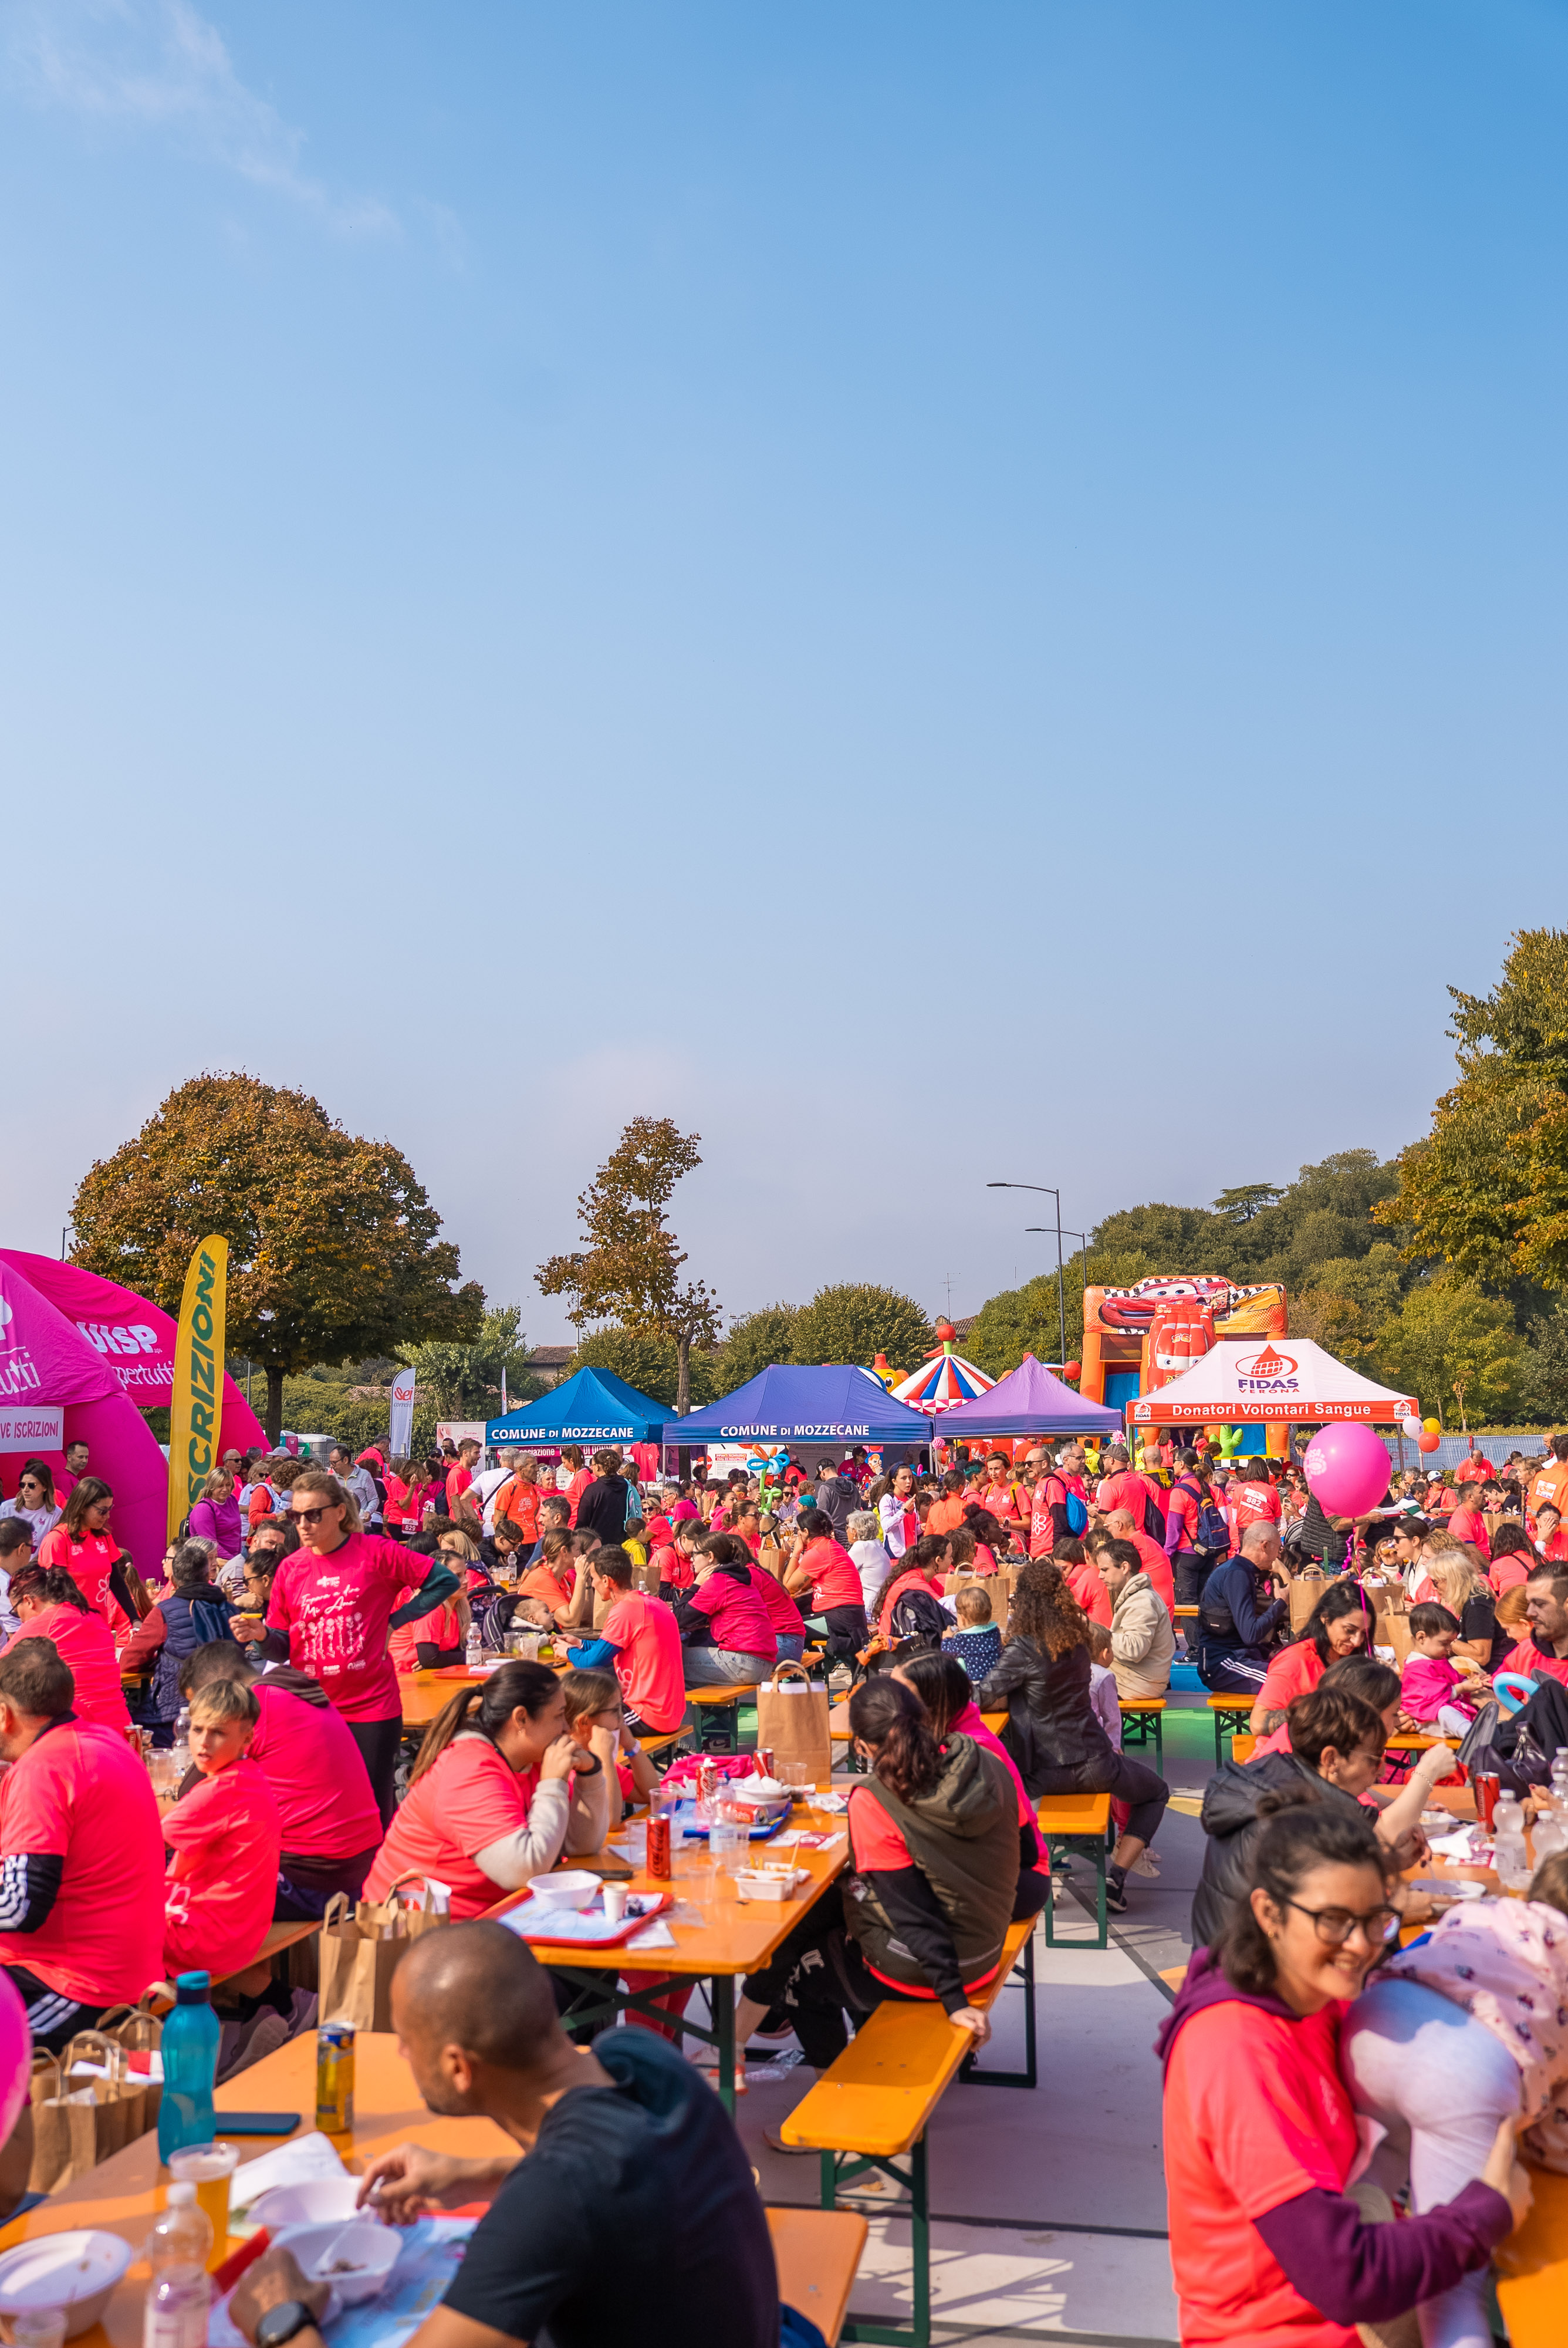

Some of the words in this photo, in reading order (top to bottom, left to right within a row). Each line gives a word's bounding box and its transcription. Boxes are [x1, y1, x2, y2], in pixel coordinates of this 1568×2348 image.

[76, 1321, 157, 1354] UISP
[188, 1249, 217, 1511] SCRIZIONI
[1238, 1378, 1299, 1389] FIDAS
[394, 1386, 414, 1401] Sei
[1172, 1403, 1236, 1416] Donatori
[1243, 1402, 1309, 1415] Volontari
[1314, 1403, 1371, 1417] Sangue
[14, 1421, 59, 1439] ISCRIZIONI
[491, 1428, 546, 1439] COMUNE
[562, 1427, 634, 1438] MOZZECANE
[720, 1425, 778, 1436] COMUNE
[780, 1427, 790, 1436] DI
[794, 1425, 870, 1436] MOZZECANE
[583, 1445, 590, 1455] DI
[1246, 1496, 1262, 1507] 882
